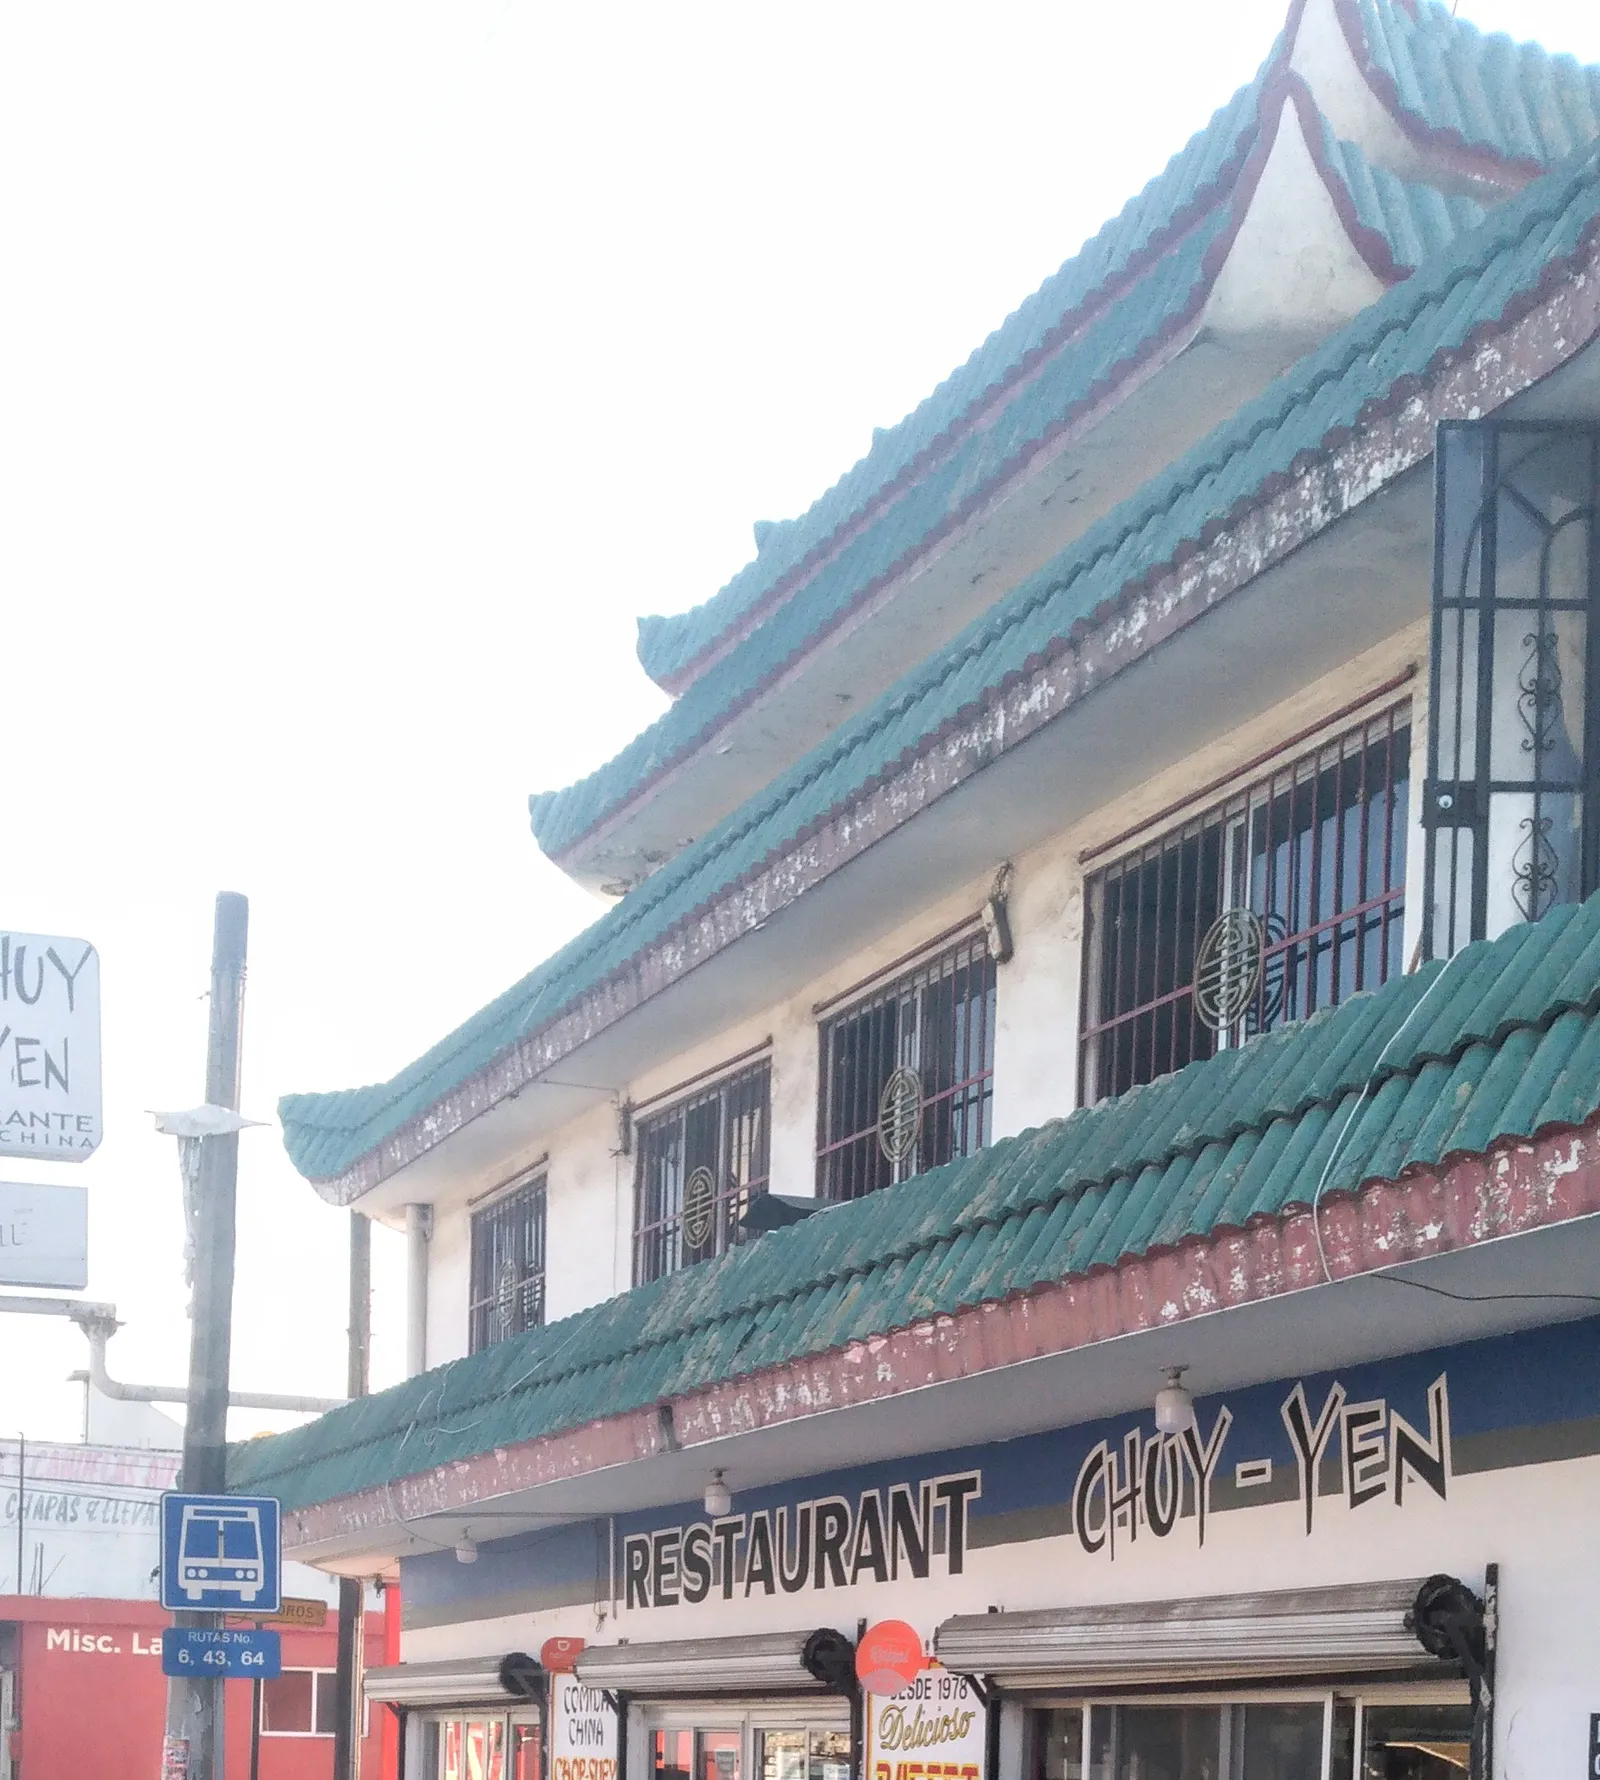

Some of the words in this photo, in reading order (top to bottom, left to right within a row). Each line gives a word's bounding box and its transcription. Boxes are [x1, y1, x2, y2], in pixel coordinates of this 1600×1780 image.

[0, 1110, 93, 1133] ANTE
[1281, 1372, 1452, 1537] YEN
[5, 1493, 81, 1524] CHAPAS
[102, 1499, 160, 1527] ELEVA
[624, 1470, 982, 1610] RESTAURANT
[46, 1628, 121, 1654] Misc.
[188, 1631, 230, 1643] RUTAS
[233, 1633, 253, 1644] No.
[178, 1649, 195, 1666] 6,
[203, 1650, 232, 1667] 43,
[241, 1651, 265, 1666] 64
[938, 1677, 968, 1700] 1978
[568, 1717, 604, 1747] CHINA
[878, 1703, 976, 1752] Delicioso
